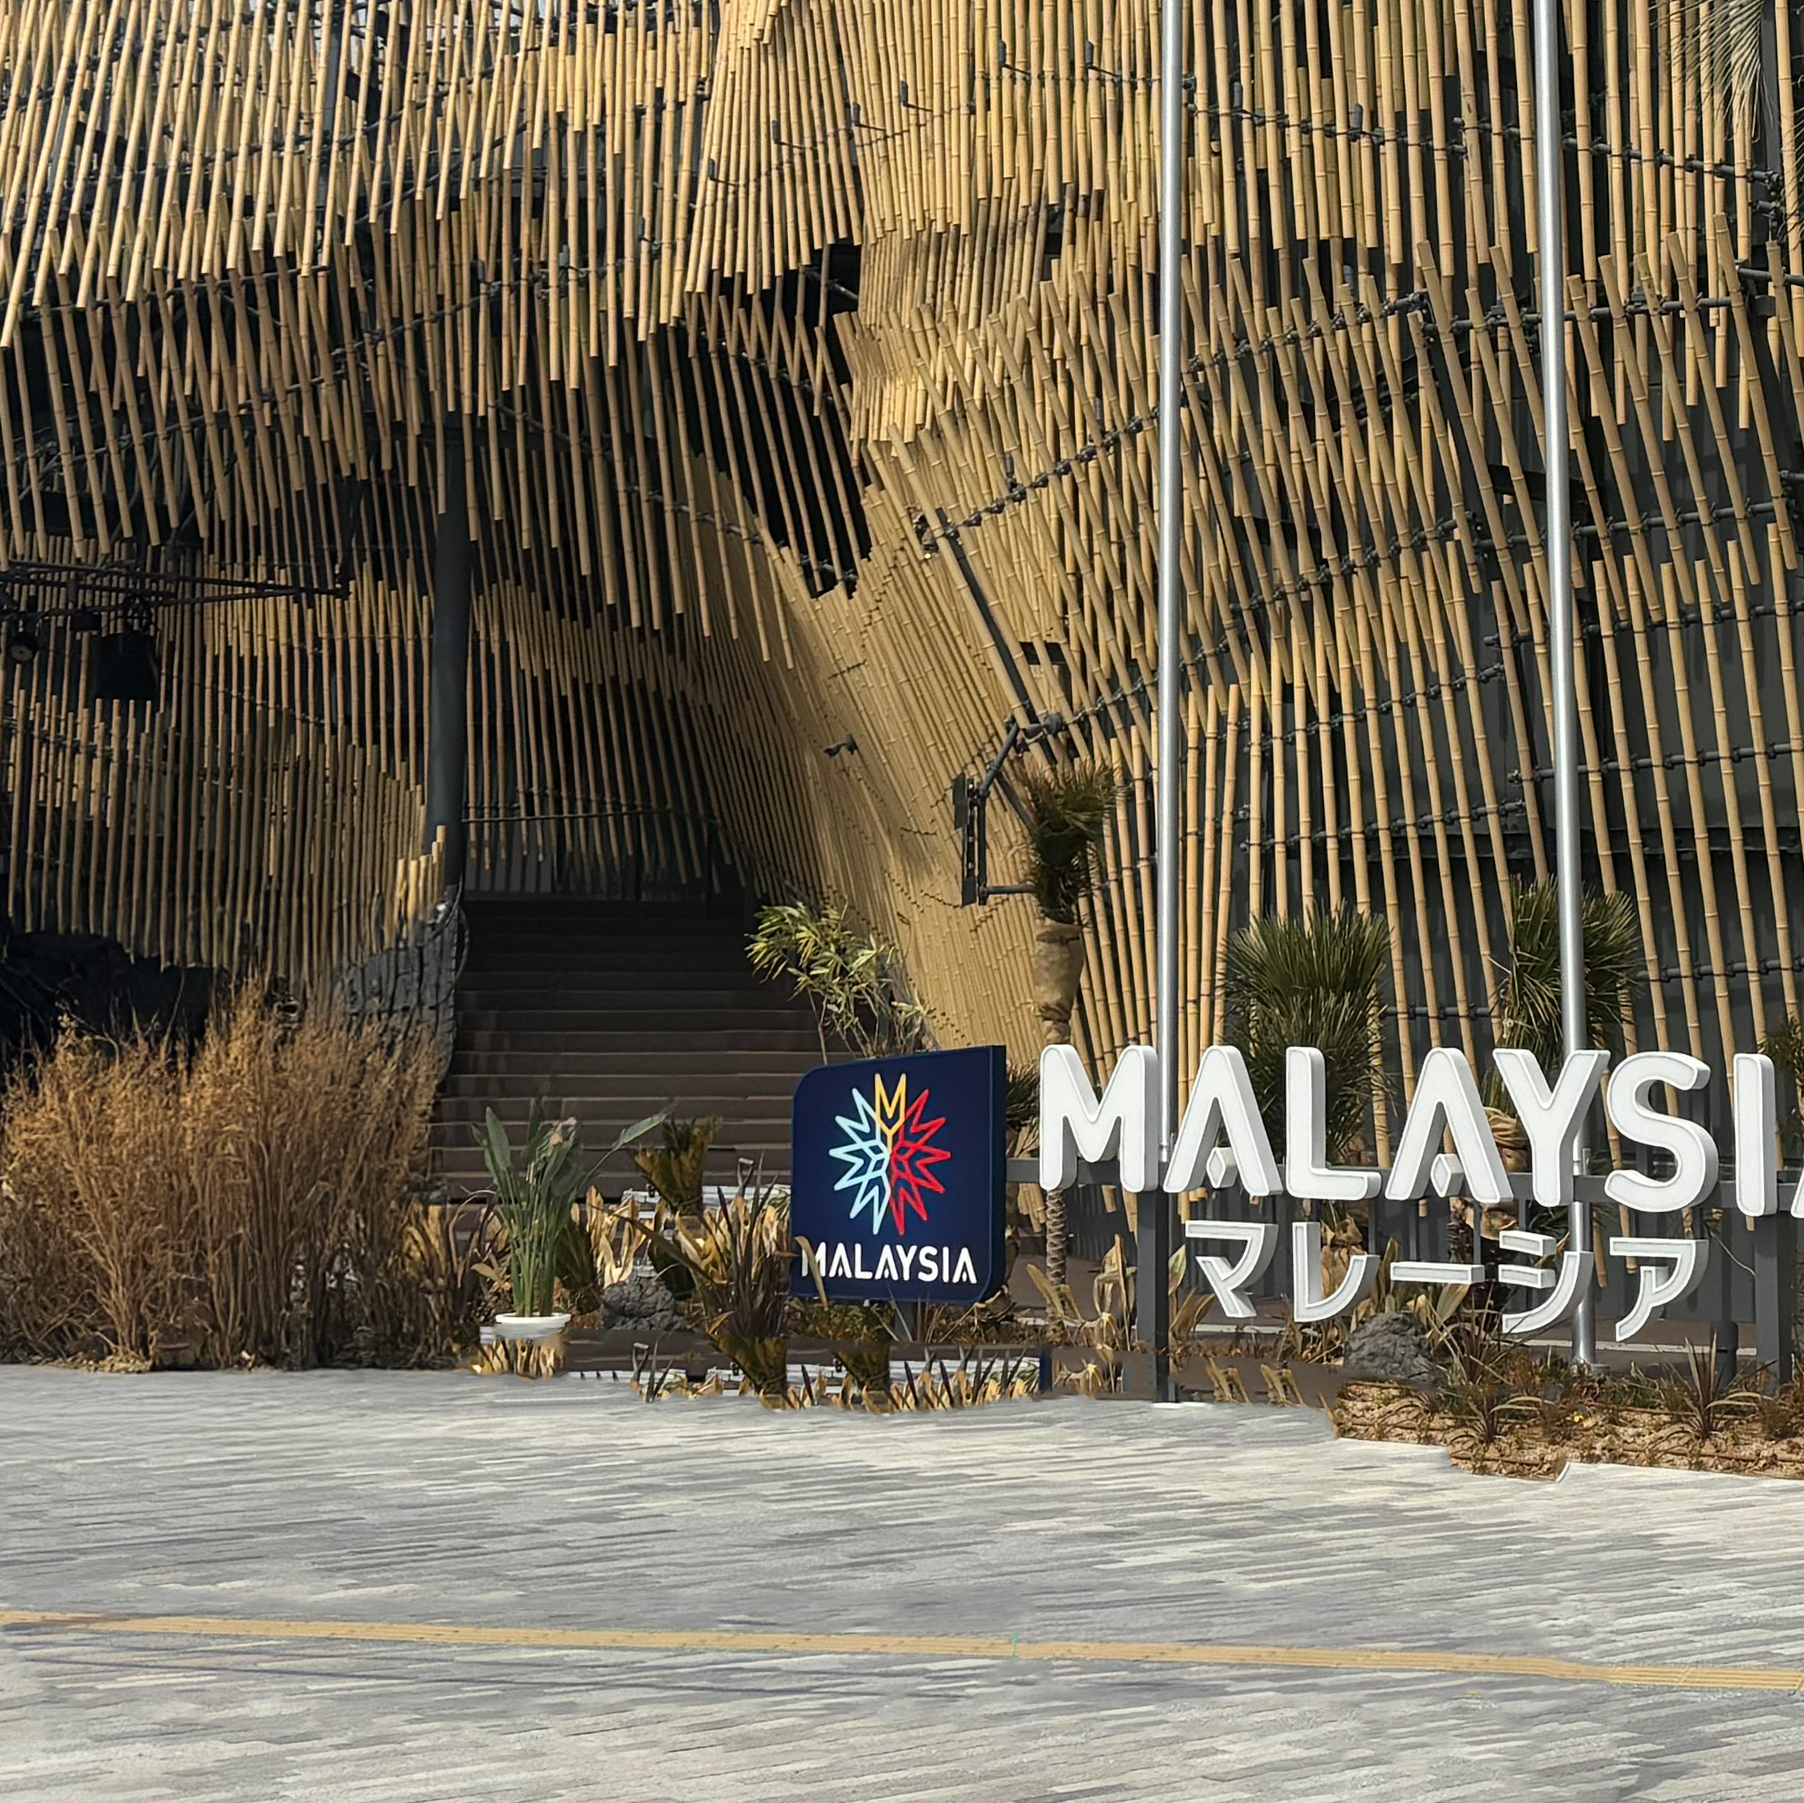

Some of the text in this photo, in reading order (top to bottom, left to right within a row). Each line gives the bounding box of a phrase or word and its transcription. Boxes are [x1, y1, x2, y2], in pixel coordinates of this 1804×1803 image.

[801, 1242, 977, 1284] MALAYSIA
[1185, 1220, 1708, 1342] マレーシア
